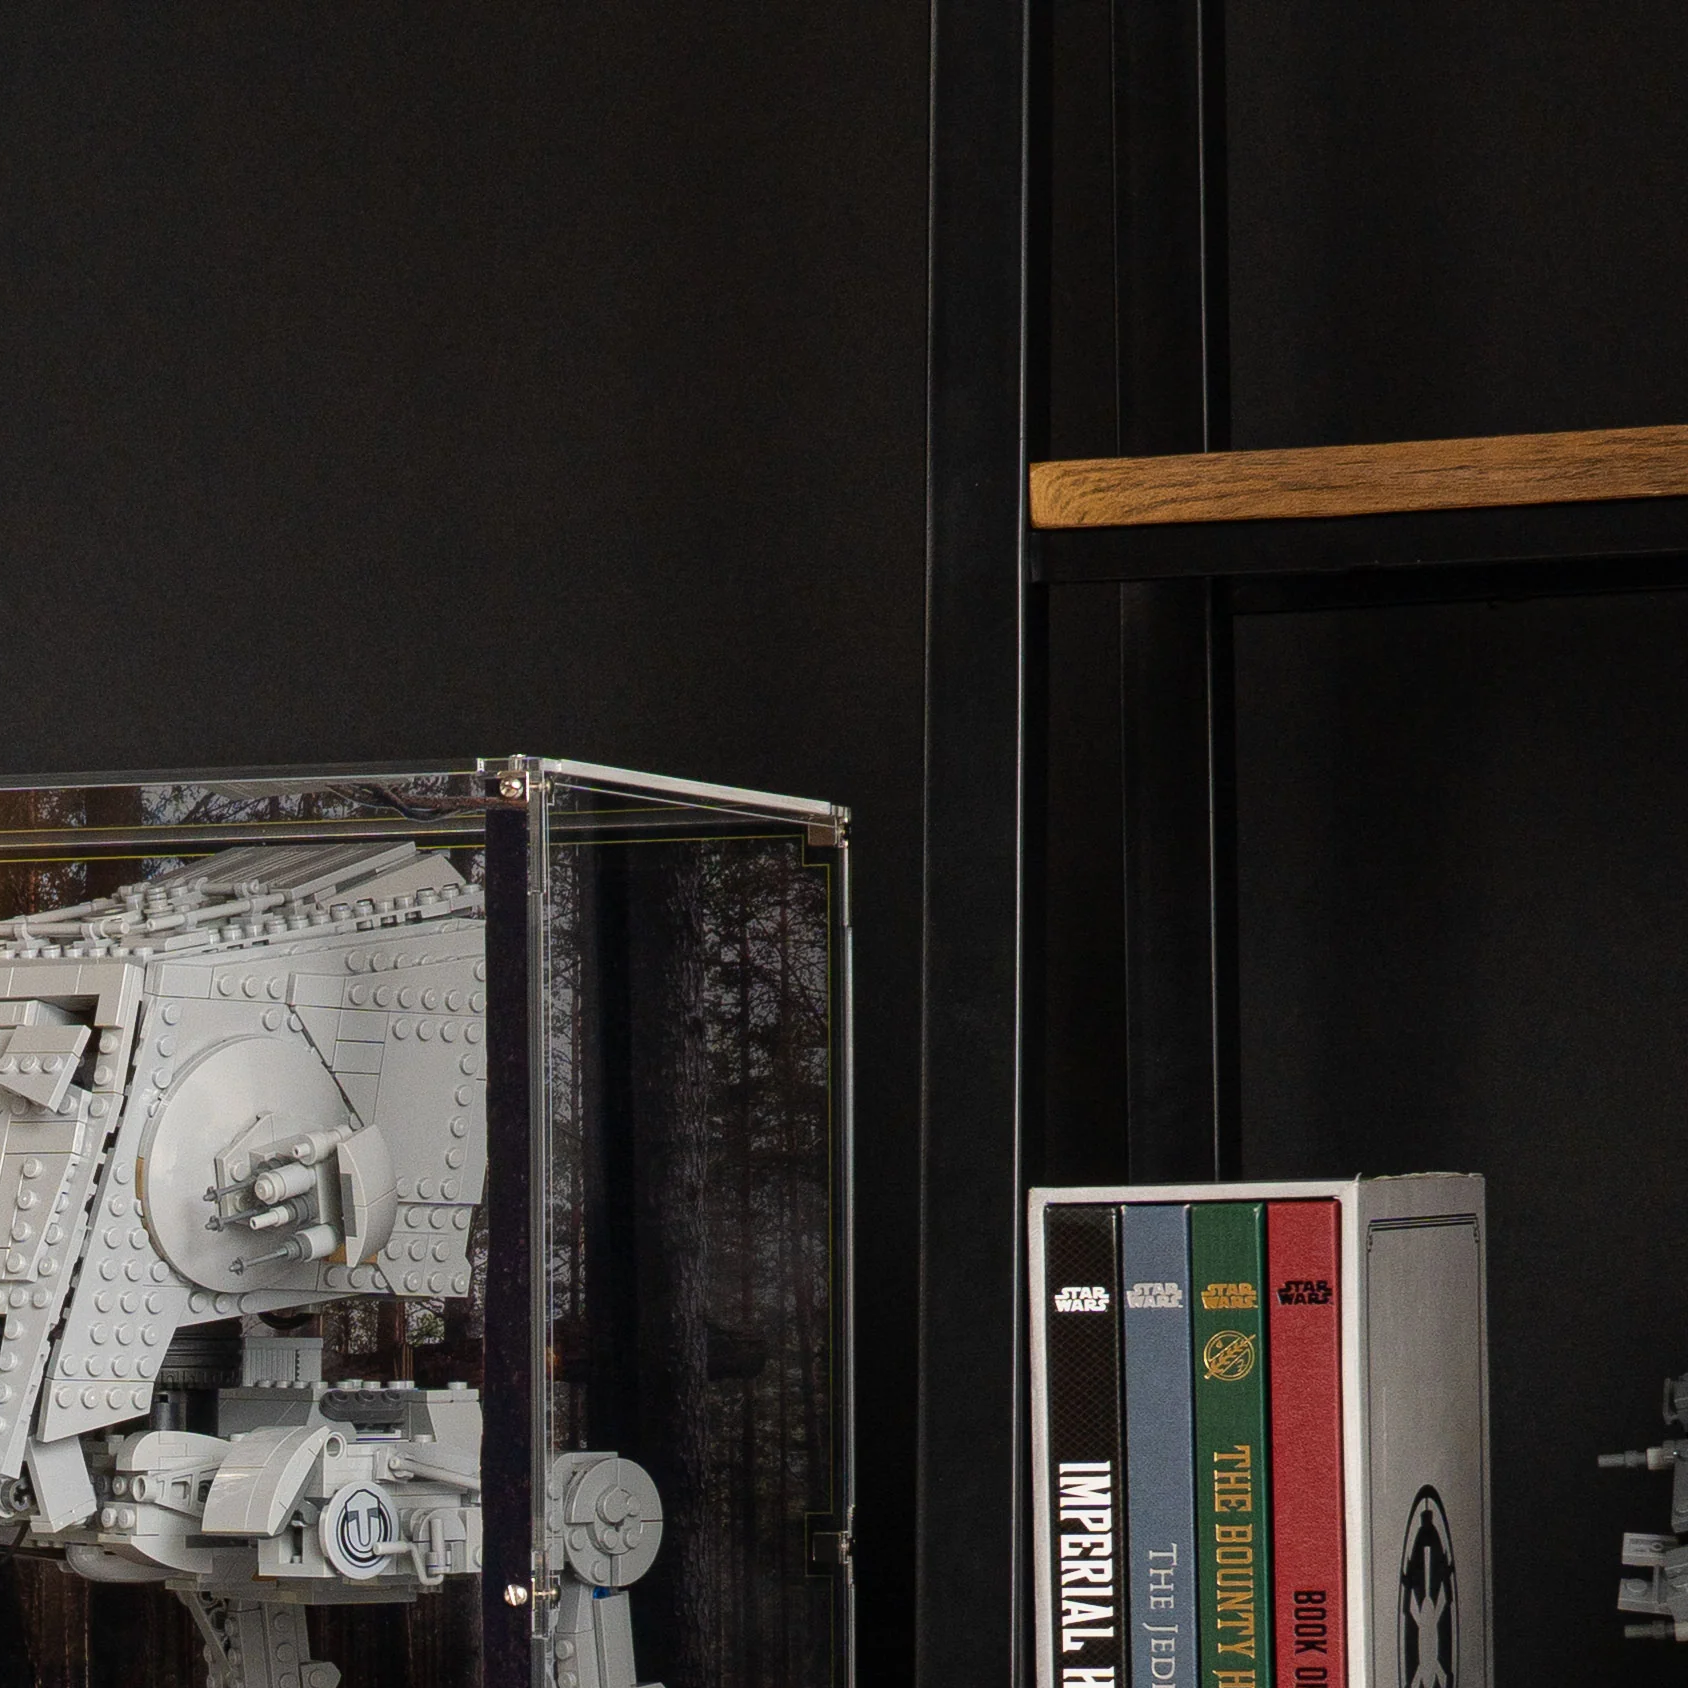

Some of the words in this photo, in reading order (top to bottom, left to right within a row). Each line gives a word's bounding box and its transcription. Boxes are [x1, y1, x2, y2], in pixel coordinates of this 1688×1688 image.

[1054, 1286, 1109, 1299] STAR
[1127, 1282, 1183, 1296] STAR
[1203, 1282, 1258, 1296] STAR
[1278, 1280, 1333, 1294] STAR
[1055, 1298, 1109, 1312] WARS
[1126, 1293, 1183, 1309] WARS
[1201, 1293, 1258, 1309] WARS
[1277, 1292, 1333, 1306] WARS
[1213, 1444, 1252, 1512] THE
[1059, 1460, 1113, 1653] IMPERIAL
[1149, 1542, 1178, 1610] THE
[1216, 1523, 1256, 1659] BOUNTY
[1293, 1590, 1328, 1655] BOOK
